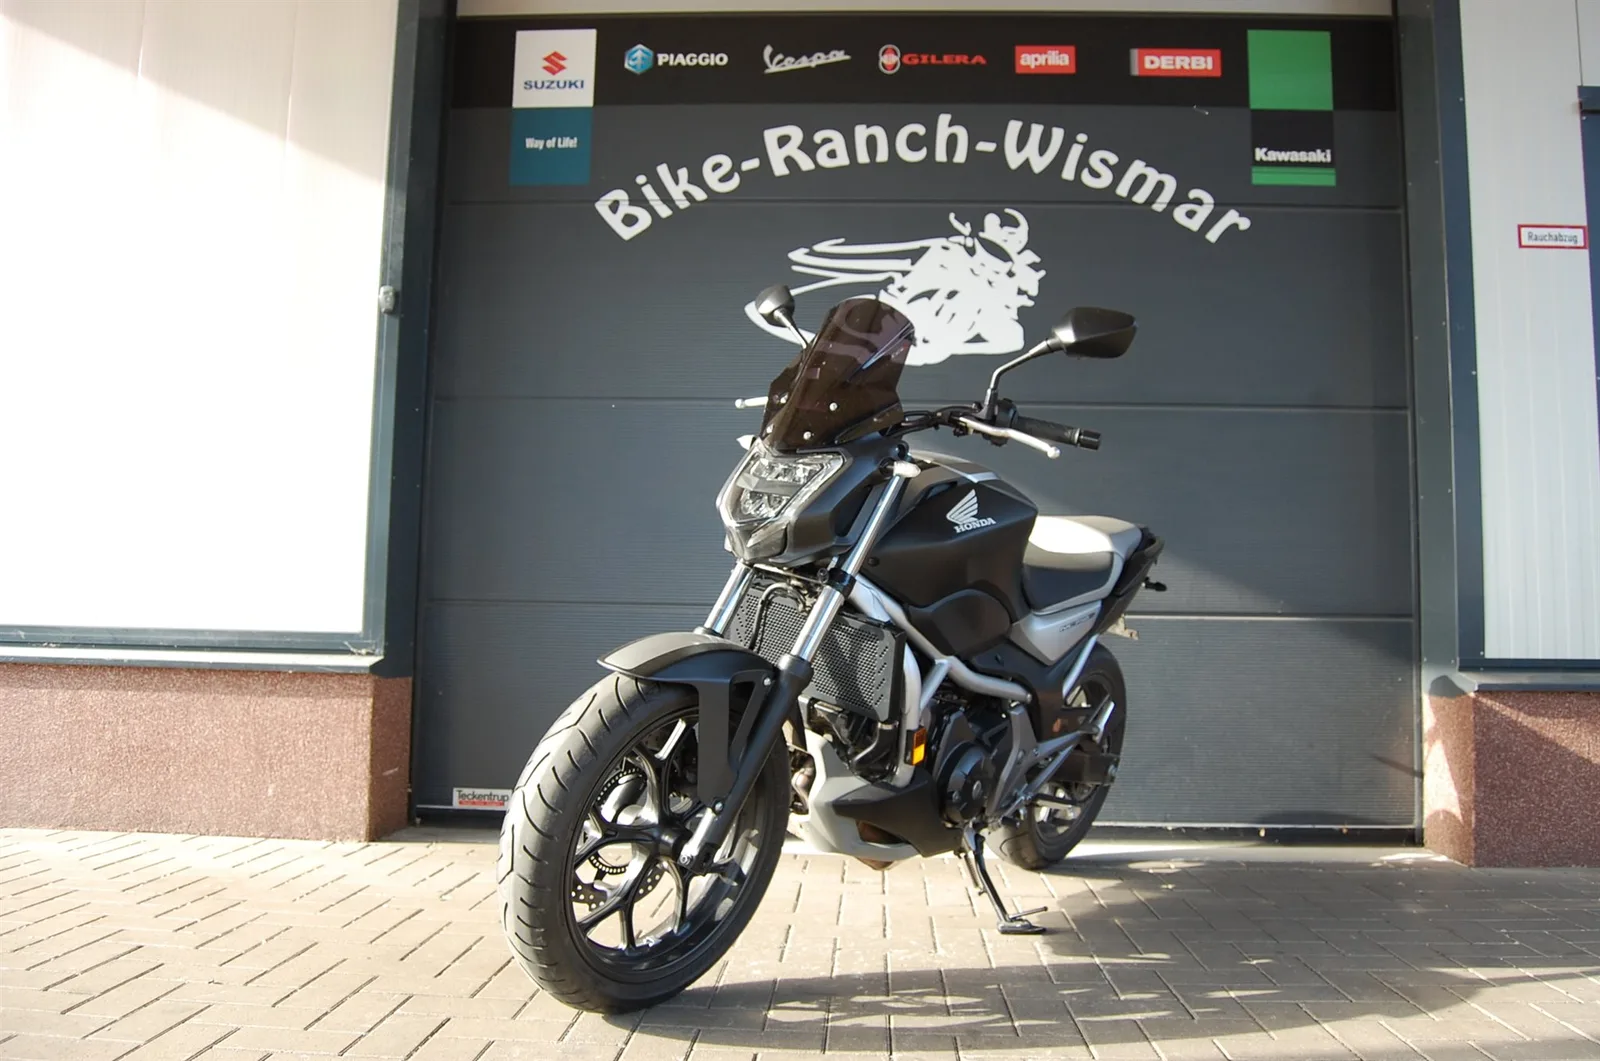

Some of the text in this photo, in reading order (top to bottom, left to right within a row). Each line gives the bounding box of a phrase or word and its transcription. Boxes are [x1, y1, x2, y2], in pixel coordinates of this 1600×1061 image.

[657, 53, 729, 67] PIAGGIO
[763, 45, 851, 73] Vespa
[901, 53, 987, 65] GILERA
[1020, 51, 1070, 69] aprilia
[1144, 55, 1213, 70] DERBI
[523, 79, 585, 90] SUZUKI
[525, 137, 578, 150] Way of Life!
[1254, 147, 1332, 163] Kawasaki
[594, 113, 1252, 243] Bike-Ranch-Wismar
[1527, 231, 1578, 244] Rauchabzug
[953, 517, 997, 533] HONDA
[456, 789, 510, 802] Teckentrup
